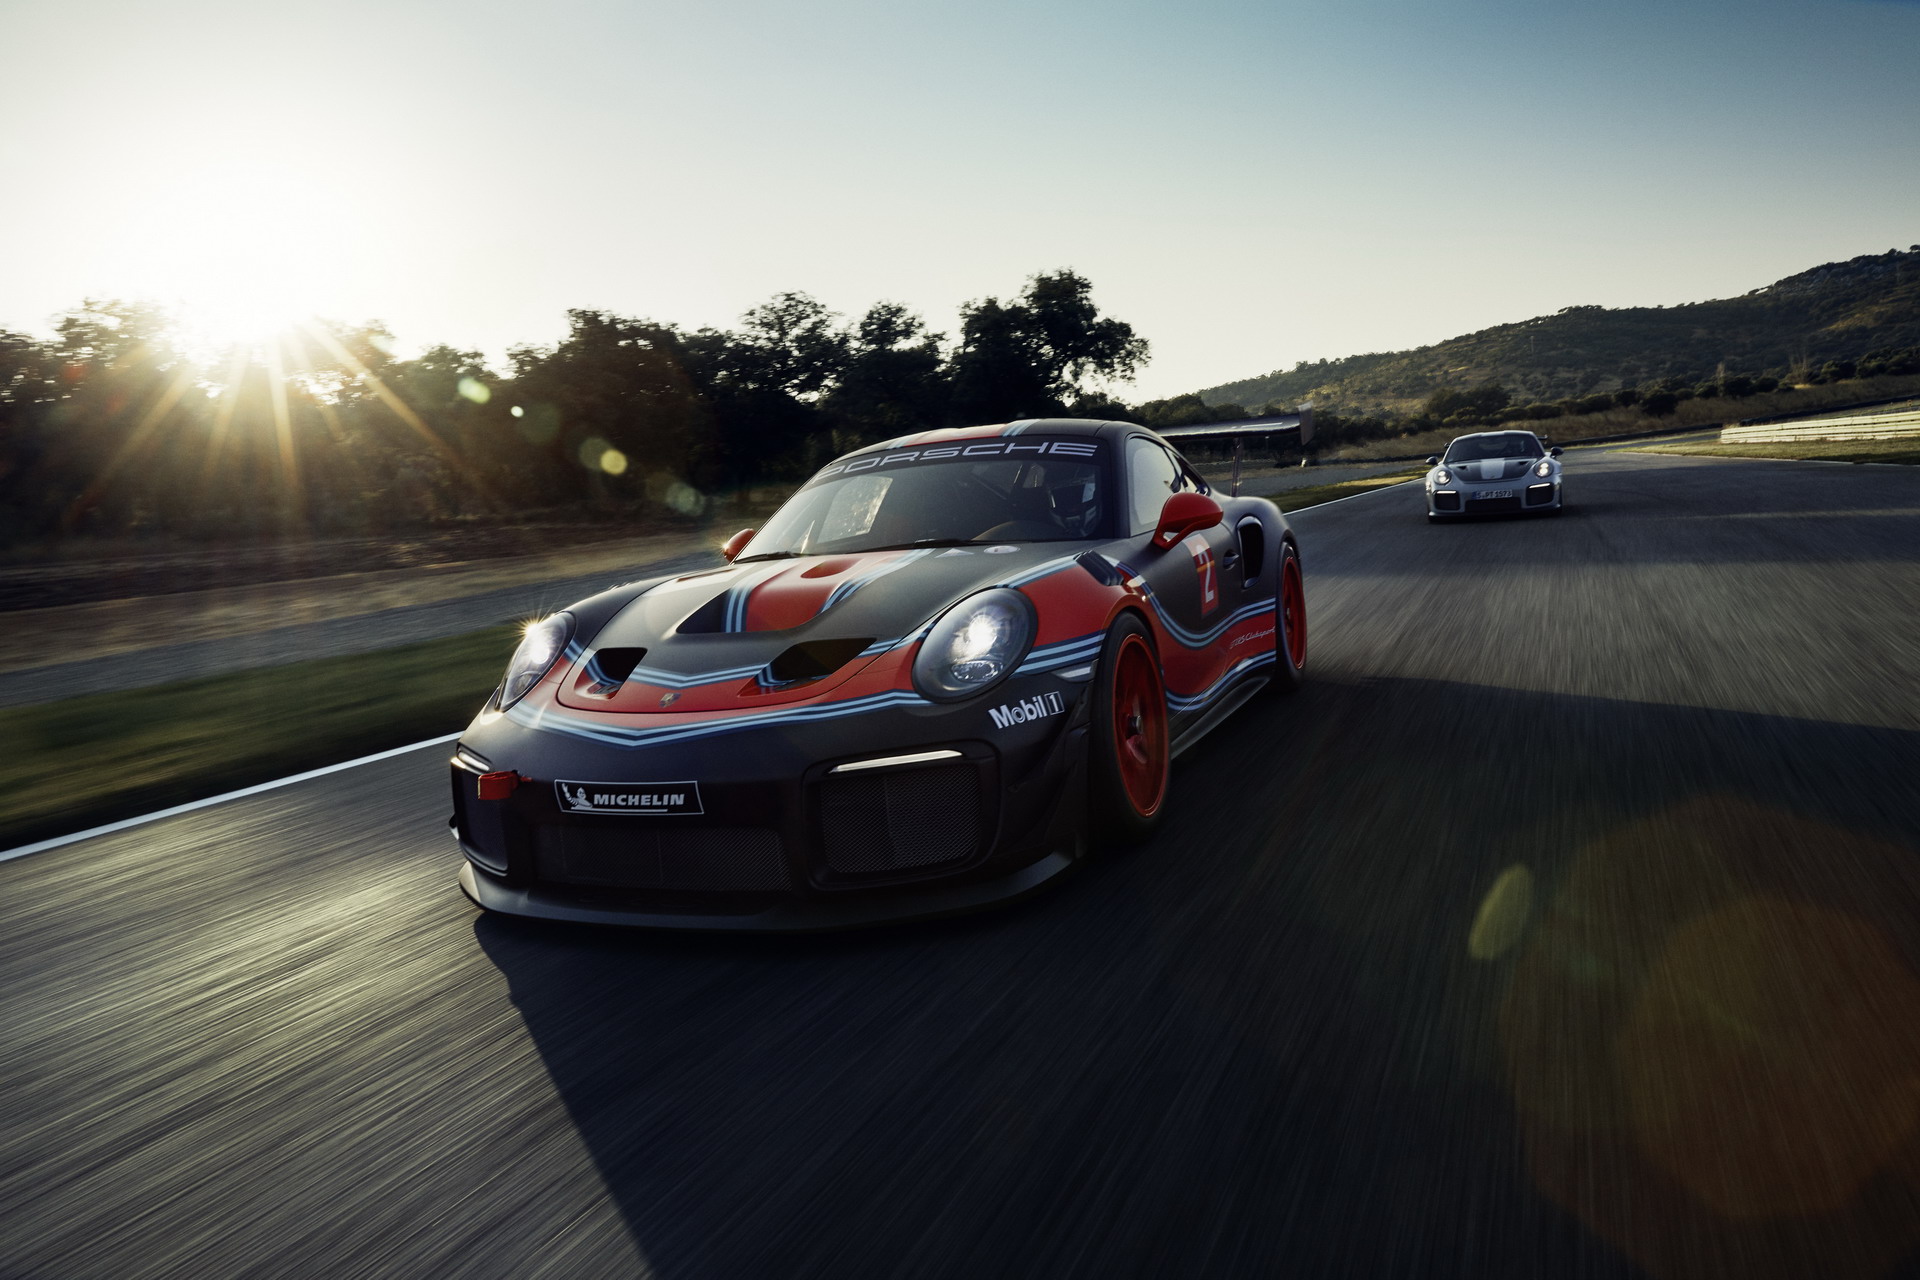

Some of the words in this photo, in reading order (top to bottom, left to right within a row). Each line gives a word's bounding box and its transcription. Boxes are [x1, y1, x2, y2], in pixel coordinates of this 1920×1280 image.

[810, 442, 1098, 485] PORSCHE
[1195, 544, 1215, 603] 2
[988, 695, 1048, 729] Mobil
[593, 794, 685, 806] MICHELIN
